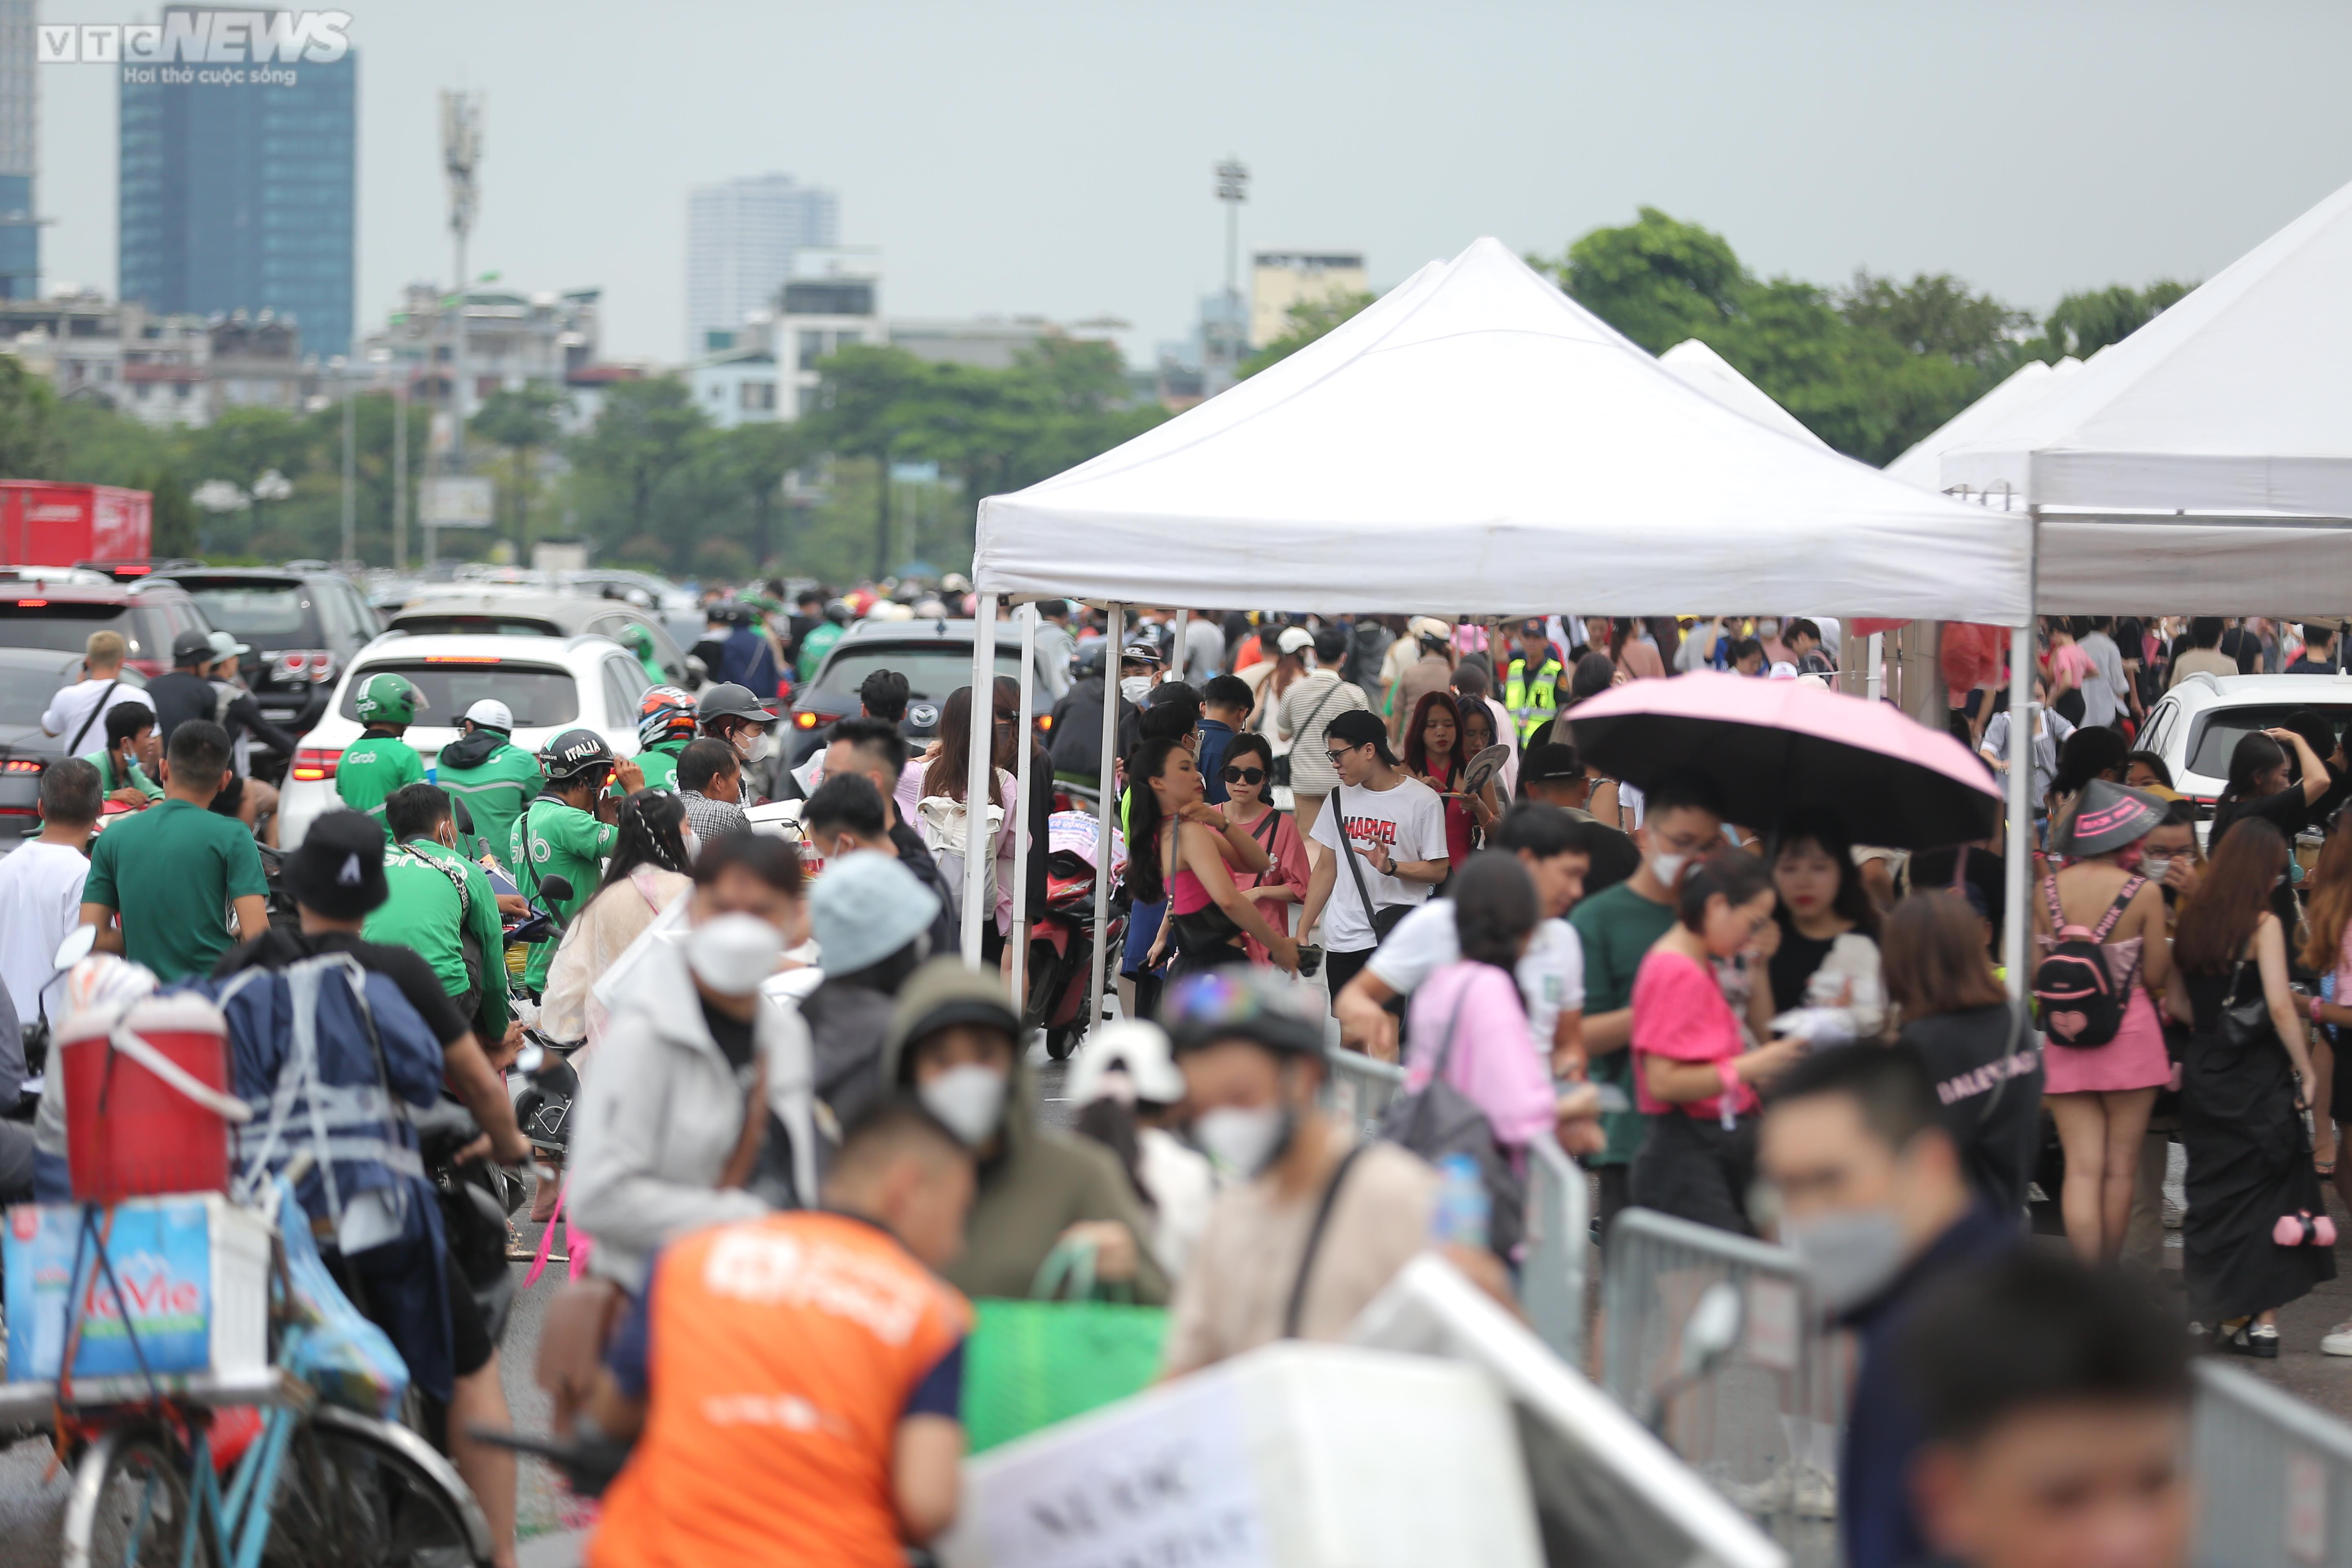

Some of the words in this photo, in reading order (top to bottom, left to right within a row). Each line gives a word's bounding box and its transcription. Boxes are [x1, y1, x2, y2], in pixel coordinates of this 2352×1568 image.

[348, 750, 377, 764] Grab
[564, 739, 601, 762] ITALIA
[1344, 816, 1397, 846] MARVEL
